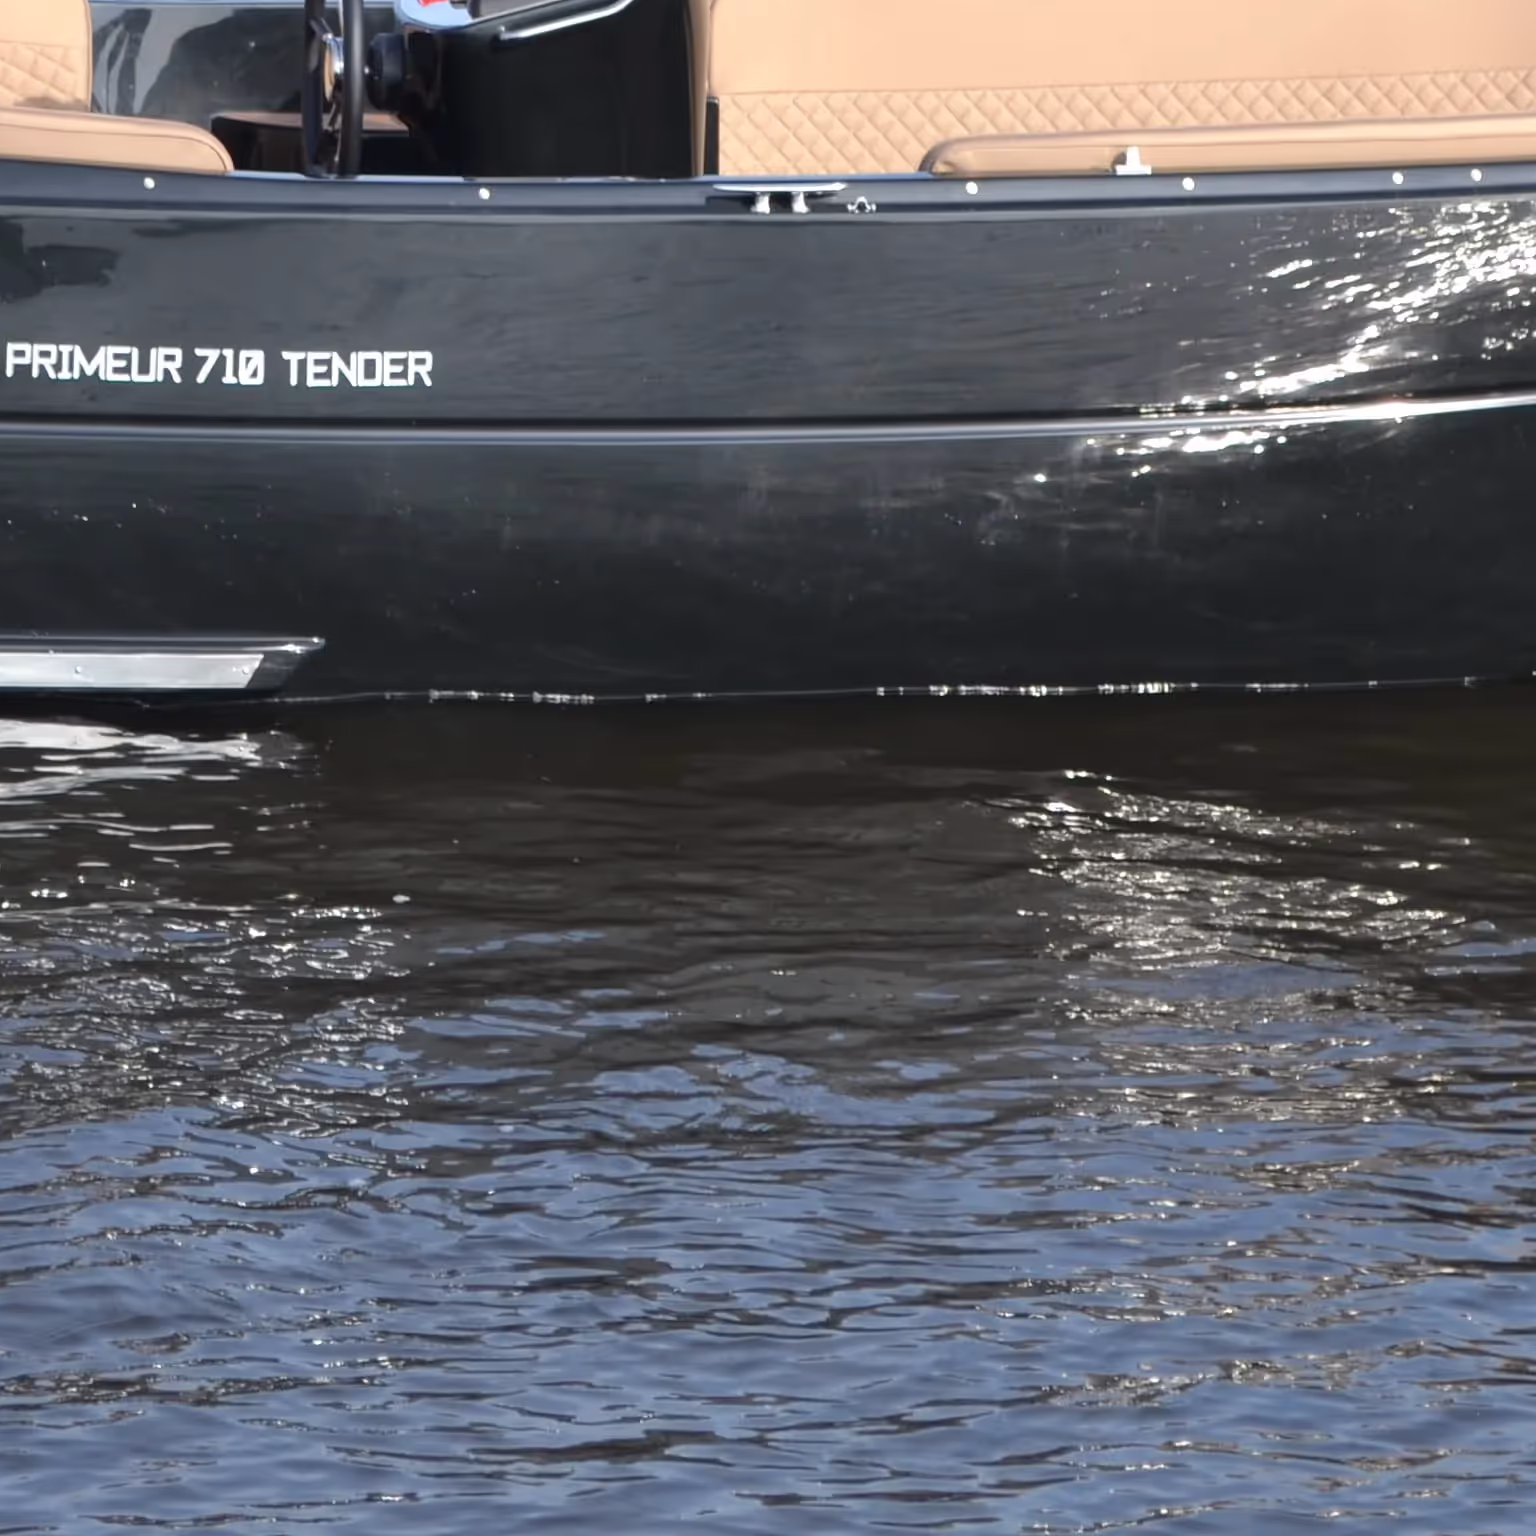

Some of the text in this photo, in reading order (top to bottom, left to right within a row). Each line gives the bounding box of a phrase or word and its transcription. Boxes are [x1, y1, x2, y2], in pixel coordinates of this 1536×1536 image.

[6, 342, 434, 388] PRIMEUR 710 TENDER
